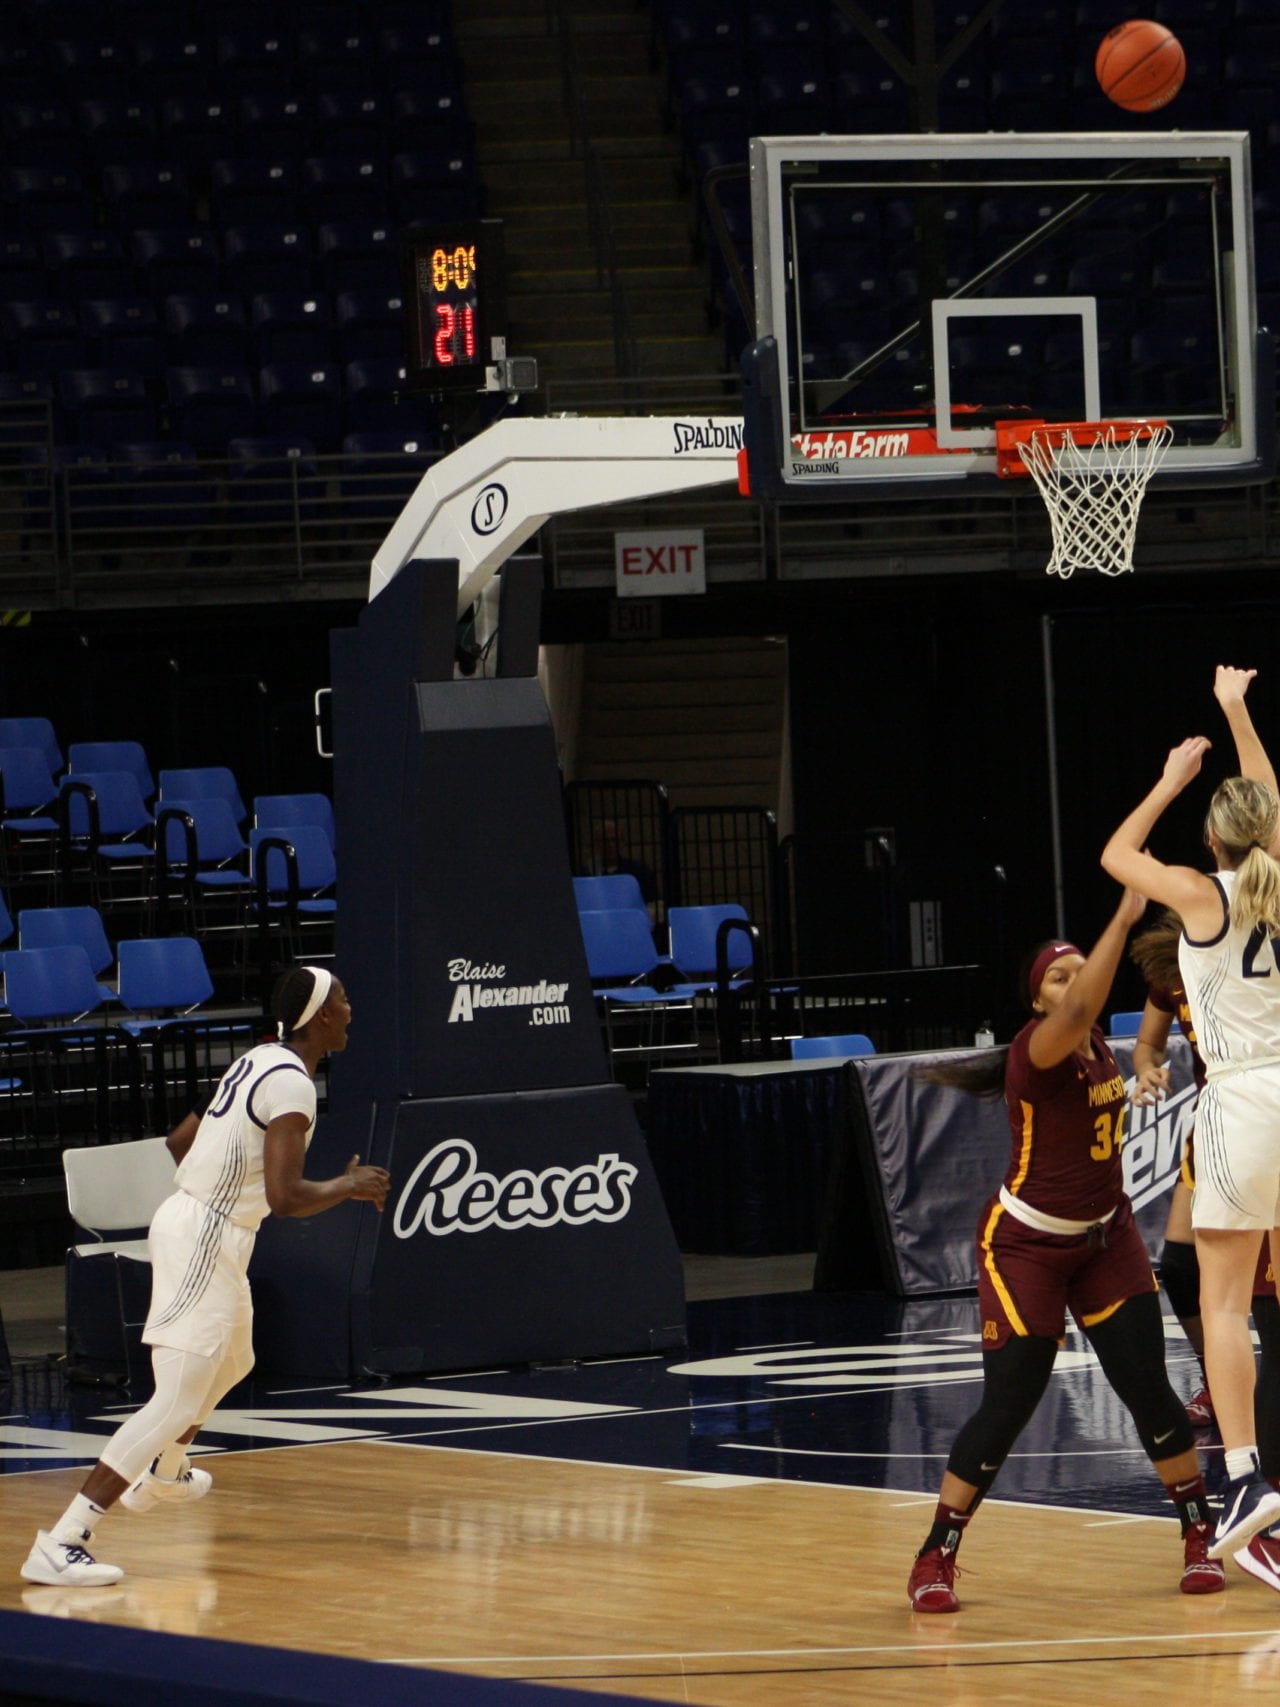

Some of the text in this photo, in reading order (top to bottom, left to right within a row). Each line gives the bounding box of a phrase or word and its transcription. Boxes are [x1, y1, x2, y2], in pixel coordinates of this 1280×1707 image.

[674, 418, 744, 453] SPALDIN
[849, 431, 909, 458] Farm
[793, 462, 839, 476] SPALDING
[622, 545, 699, 576] EXIT
[448, 957, 507, 982] Blaise
[448, 979, 569, 1023] Alexander
[529, 1005, 571, 1026] .com
[393, 1138, 639, 1239] Reese's
